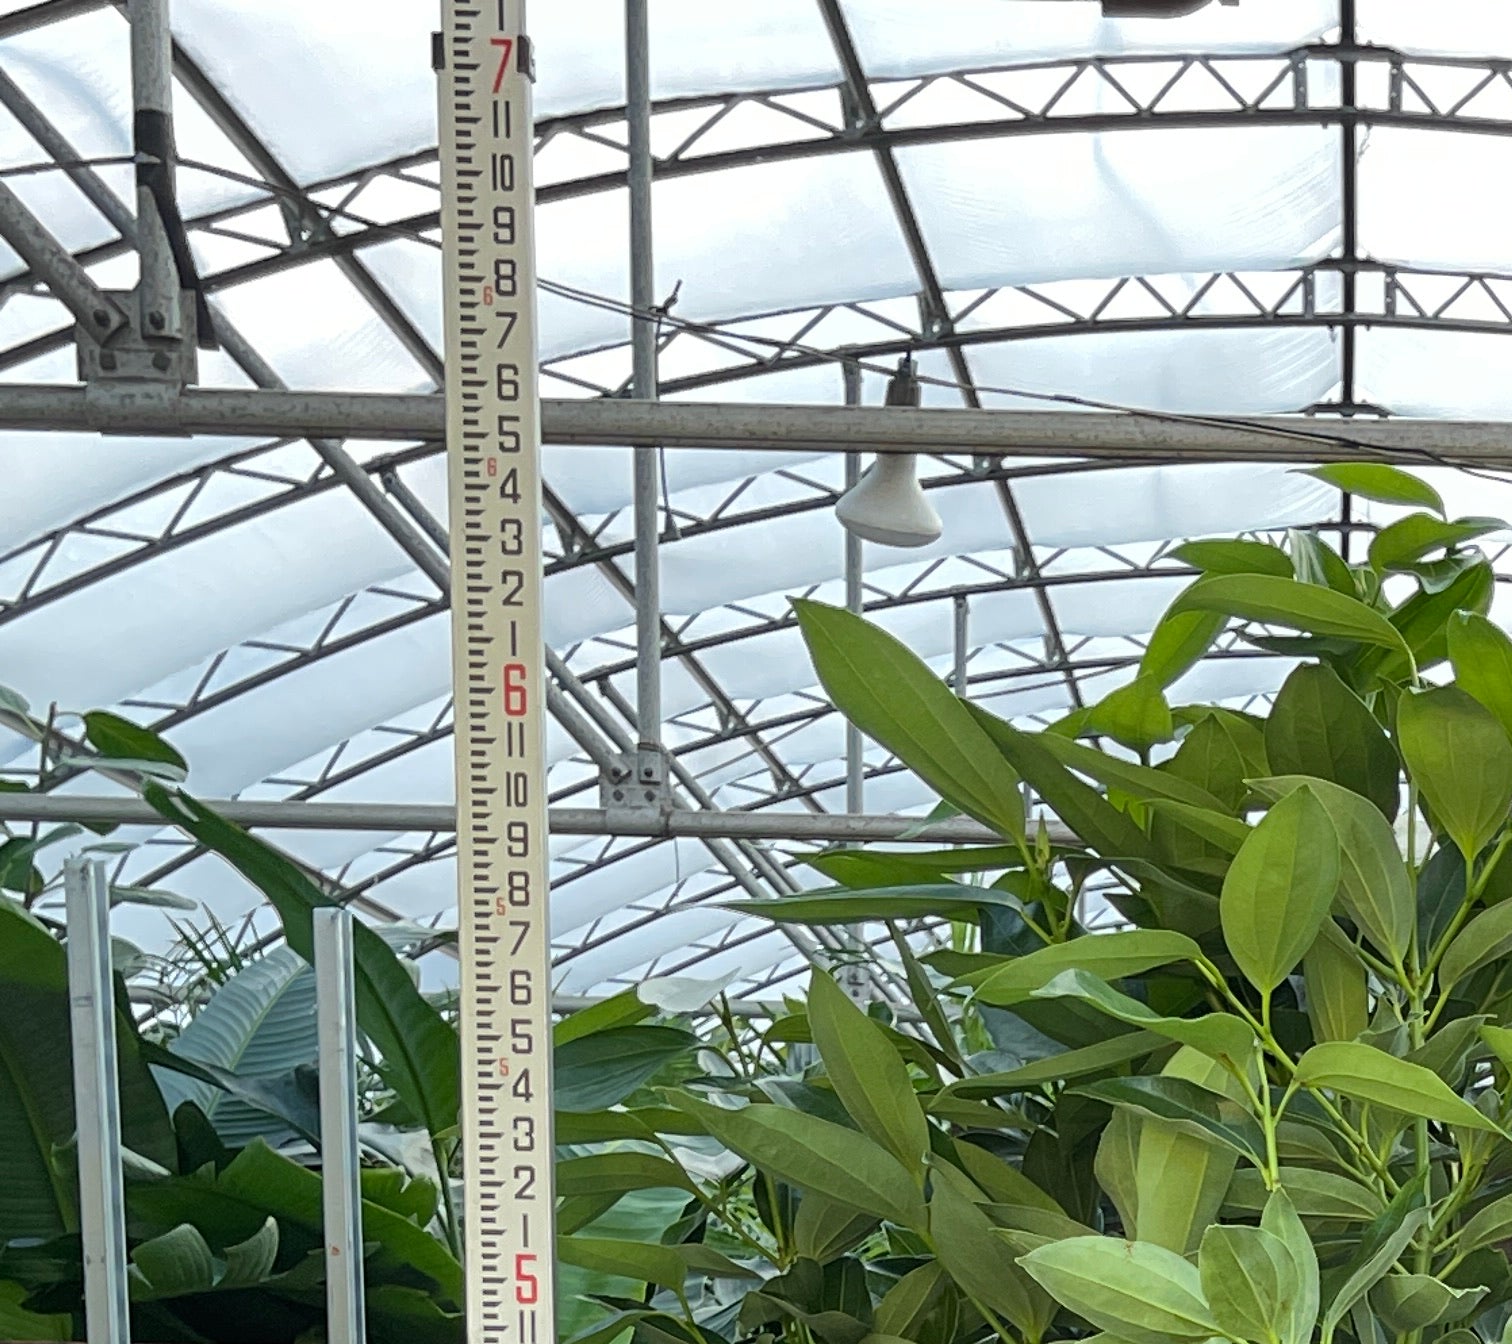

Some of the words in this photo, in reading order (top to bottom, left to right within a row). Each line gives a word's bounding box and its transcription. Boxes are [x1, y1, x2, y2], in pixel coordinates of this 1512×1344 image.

[489, 37, 514, 95] 7
[492, 99, 511, 139] 11
[491, 152, 515, 192] 10
[492, 205, 516, 245] 9
[493, 257, 517, 297] 8
[495, 311, 518, 350] 7
[496, 363, 519, 402] 6
[497, 414, 521, 454] 5
[499, 467, 522, 504] 4
[500, 518, 523, 556] 3
[501, 569, 524, 607] 2
[503, 663, 527, 717] 6
[507, 721, 525, 758] 11
[505, 771, 528, 808] 10
[506, 821, 529, 858] 9
[507, 870, 530, 907] 8
[508, 920, 531, 957] 7
[509, 969, 532, 1006] 6
[510, 1017, 533, 1055] 5
[512, 1067, 534, 1103] 4
[512, 1115, 535, 1152] 3
[513, 1164, 536, 1201] 2
[515, 1253, 538, 1305] 5
[519, 1309, 537, 1344] 11
